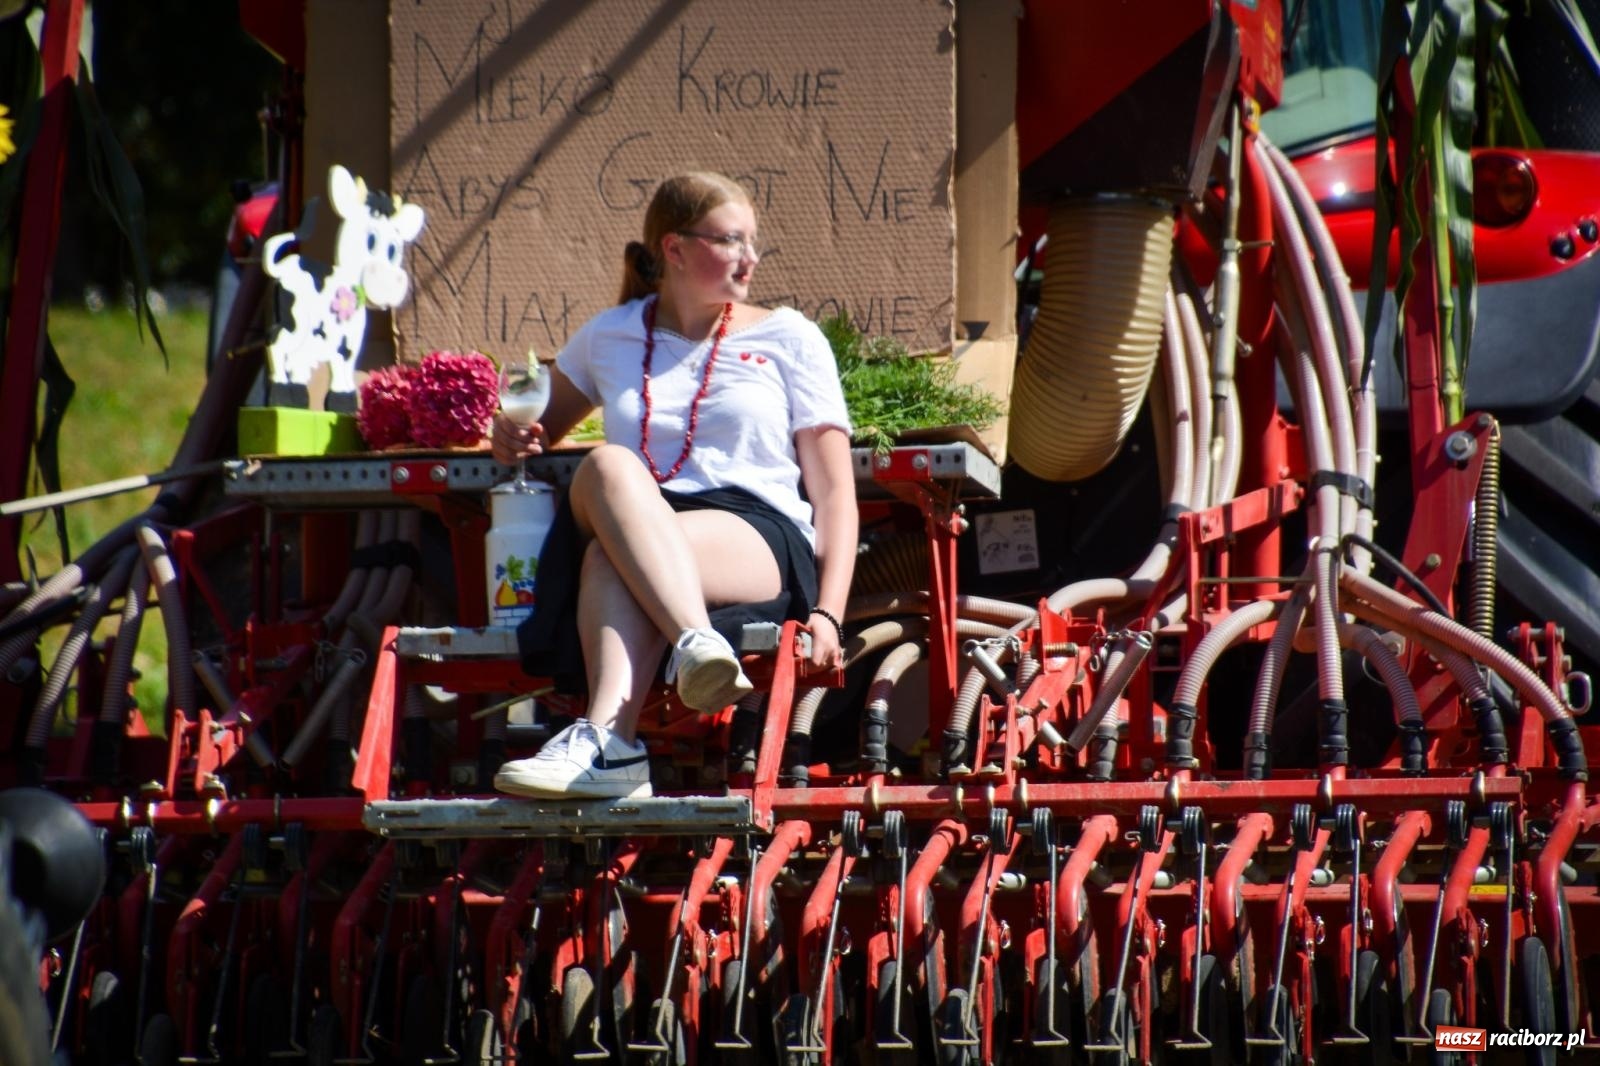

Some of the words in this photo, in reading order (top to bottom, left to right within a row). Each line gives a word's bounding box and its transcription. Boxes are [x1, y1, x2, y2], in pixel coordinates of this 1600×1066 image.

[414, 23, 614, 125] MLEKO
[677, 24, 843, 114] KROWIE
[827, 139, 918, 222] NIE
